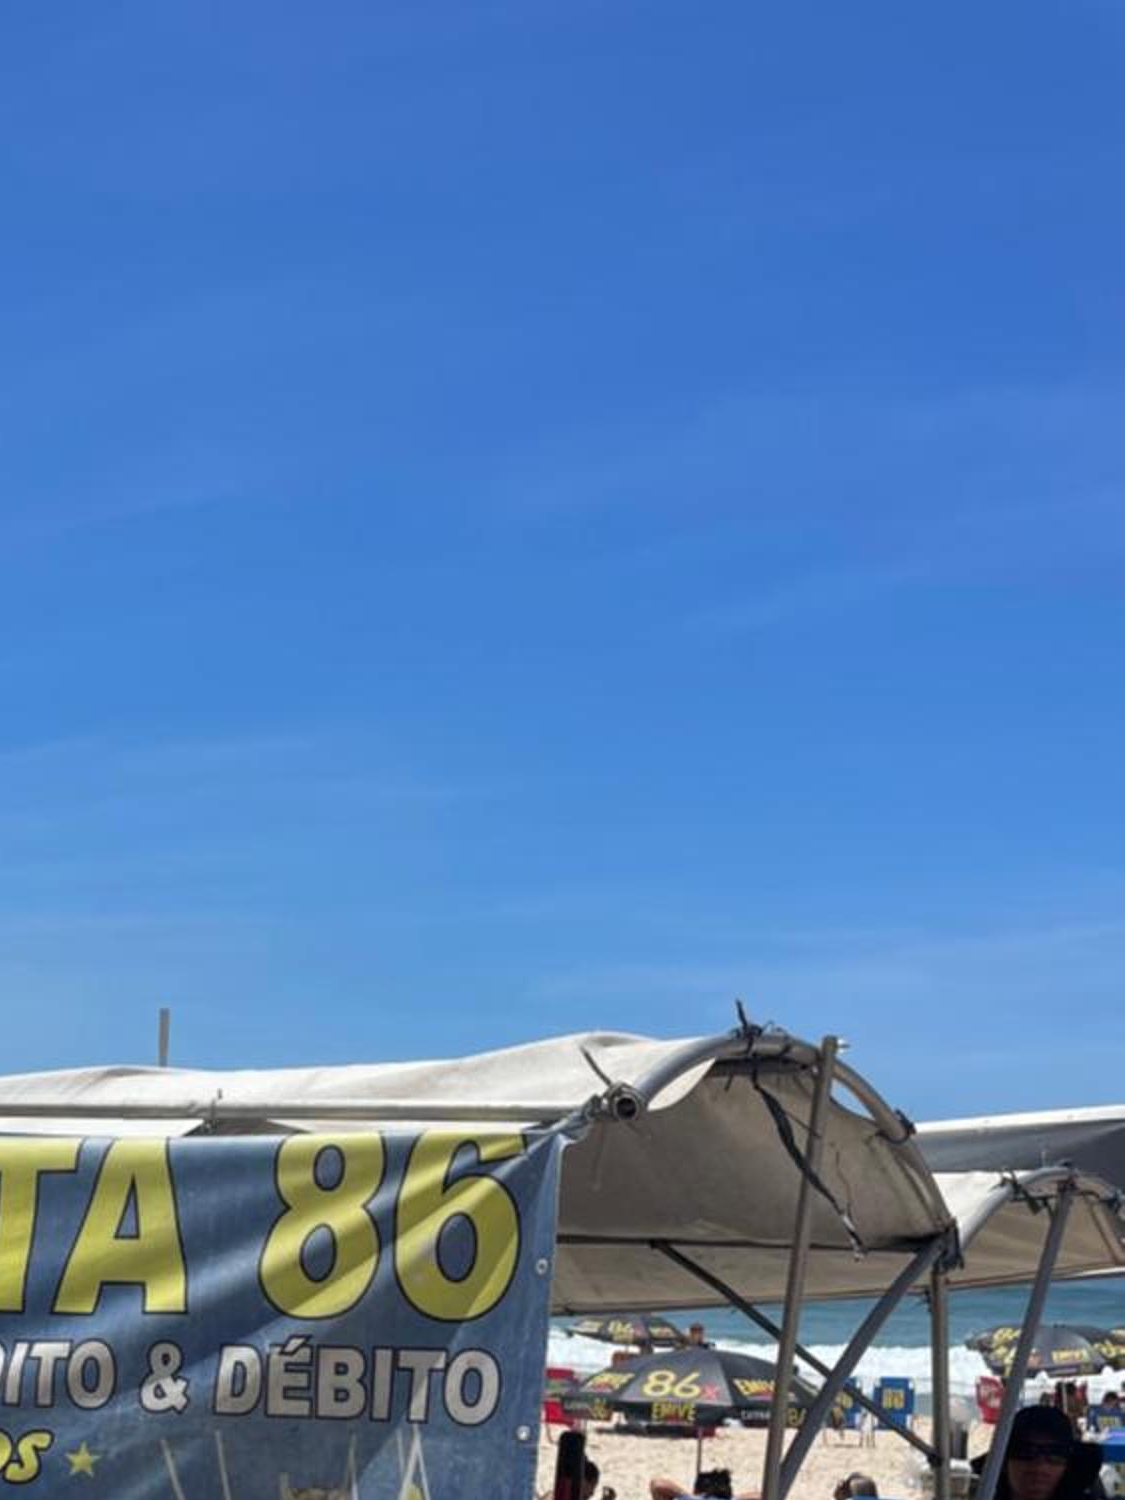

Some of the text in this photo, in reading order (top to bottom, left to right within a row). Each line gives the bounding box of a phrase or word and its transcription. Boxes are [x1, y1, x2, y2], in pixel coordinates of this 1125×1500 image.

[258, 1131, 528, 1321] 86
[140, 1340, 190, 1413] &
[214, 1337, 501, 1427] DÉBITO
[642, 1369, 700, 1398] 86
